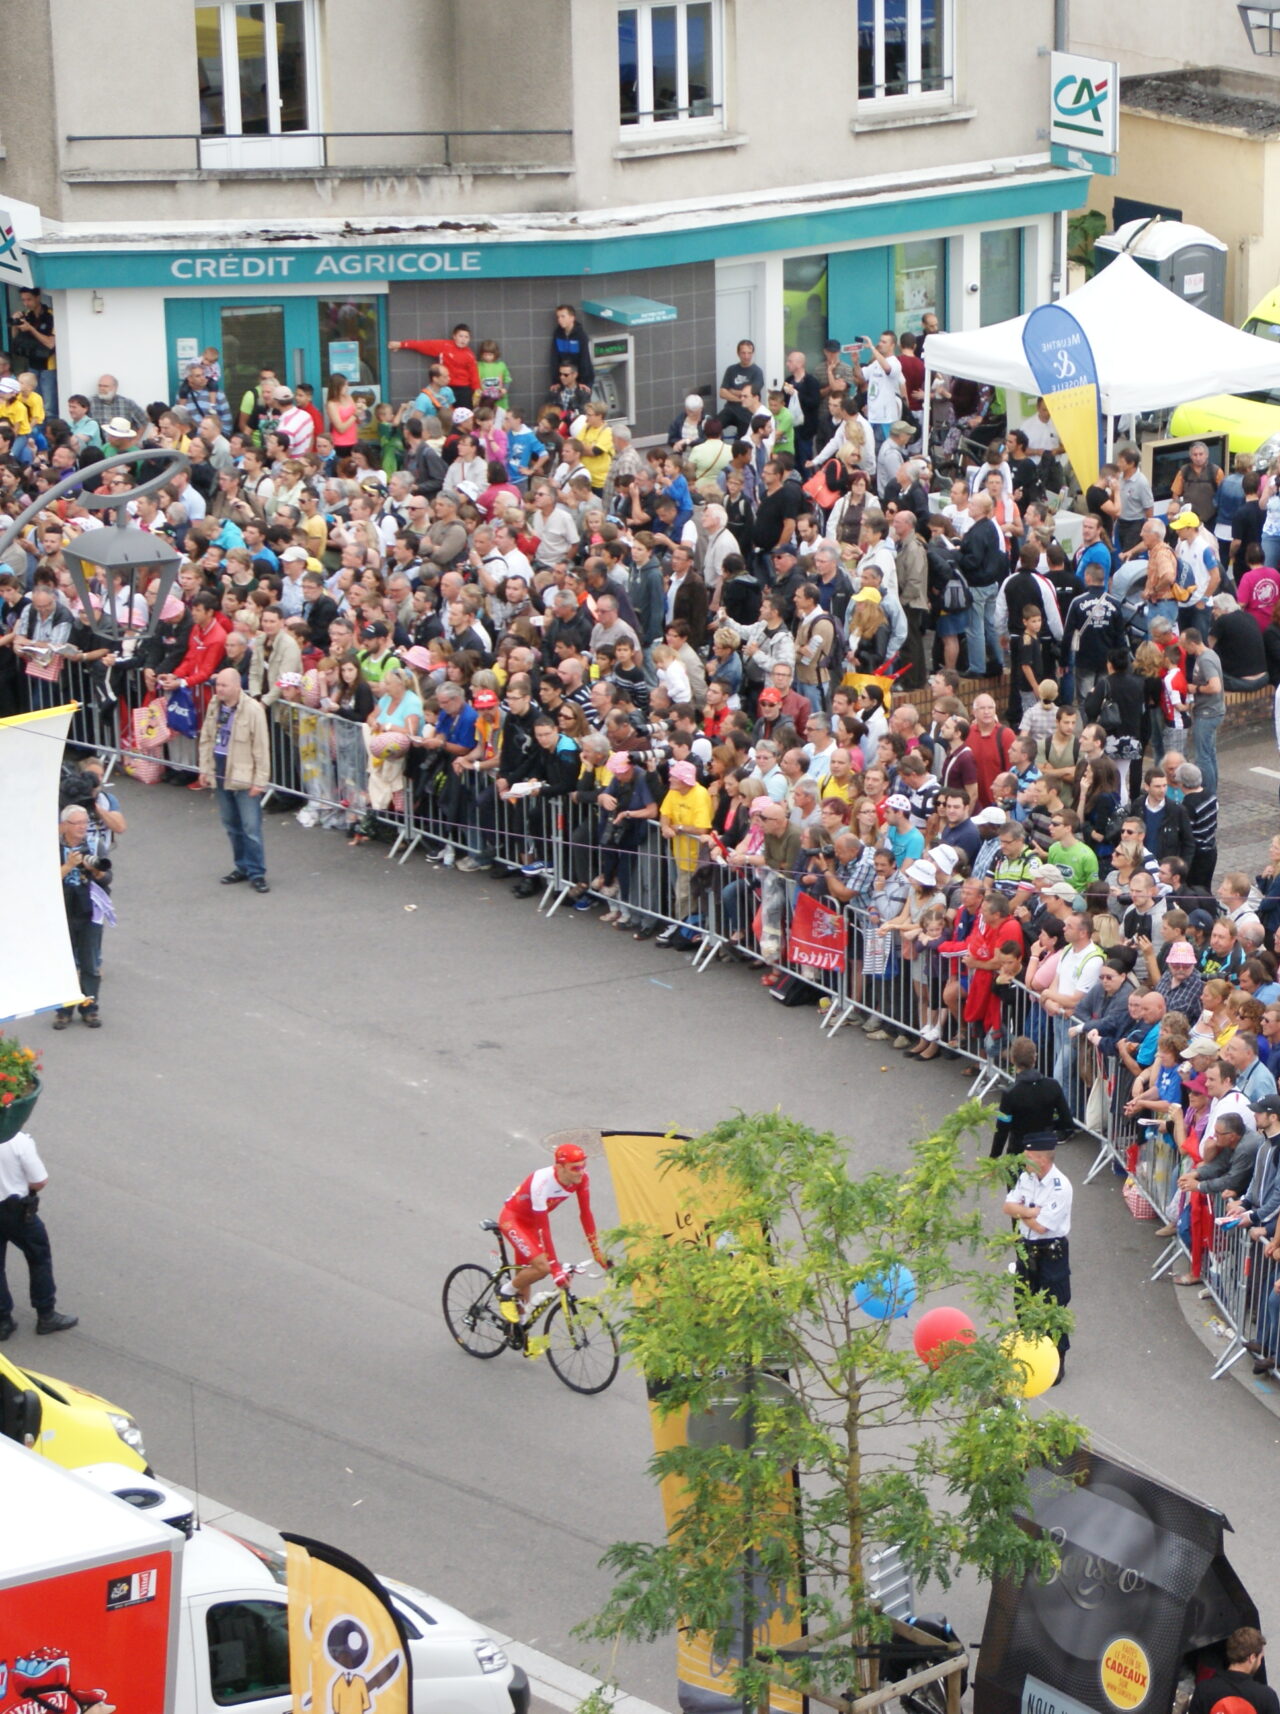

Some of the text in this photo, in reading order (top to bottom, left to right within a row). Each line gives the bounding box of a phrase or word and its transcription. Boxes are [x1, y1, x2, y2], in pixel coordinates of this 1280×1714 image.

[170, 251, 482, 280] CRÉDIT AGRICOLE
[1105, 1656, 1148, 1688] CADEAUX
